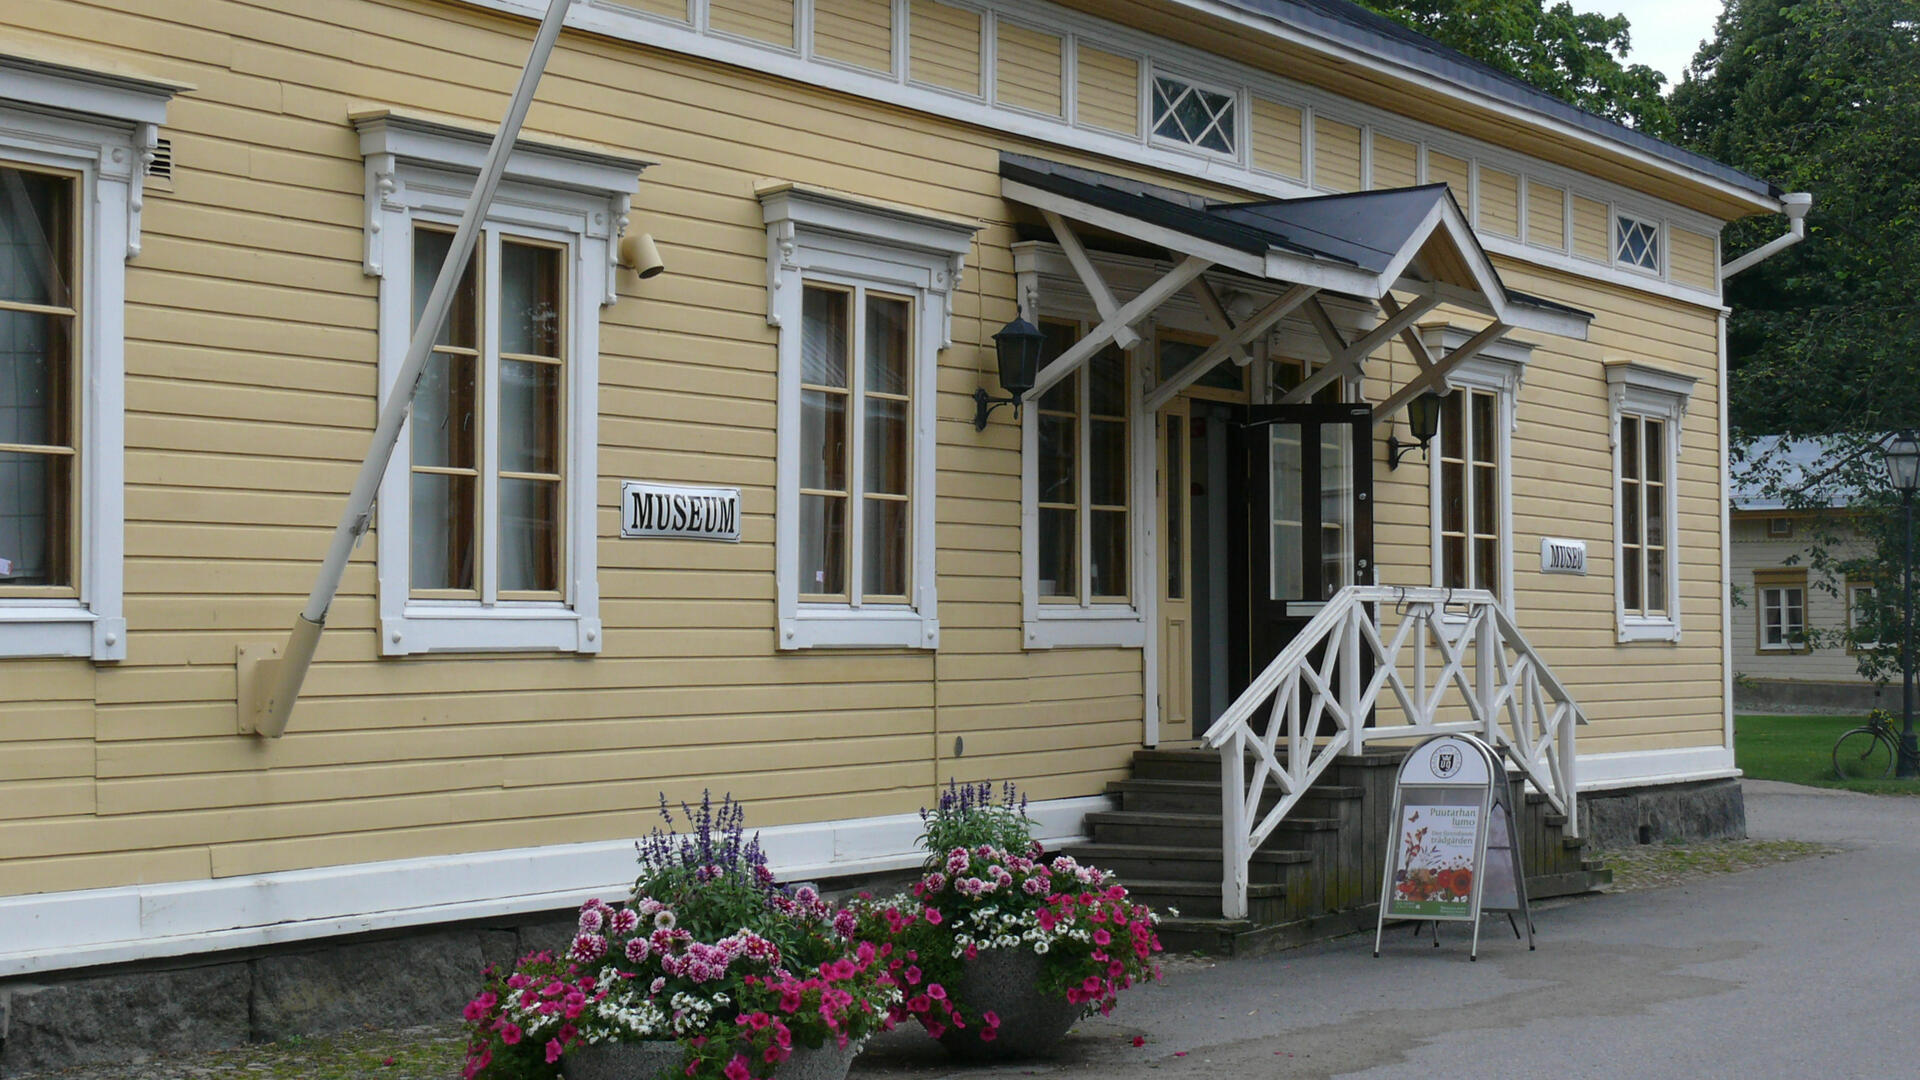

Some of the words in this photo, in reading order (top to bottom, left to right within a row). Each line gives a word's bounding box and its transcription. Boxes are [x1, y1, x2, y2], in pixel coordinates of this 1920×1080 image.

[631, 492, 735, 533] MUSEUM
[1430, 807, 1476, 817] Puutarhan
[1452, 817, 1475, 825] lumo
